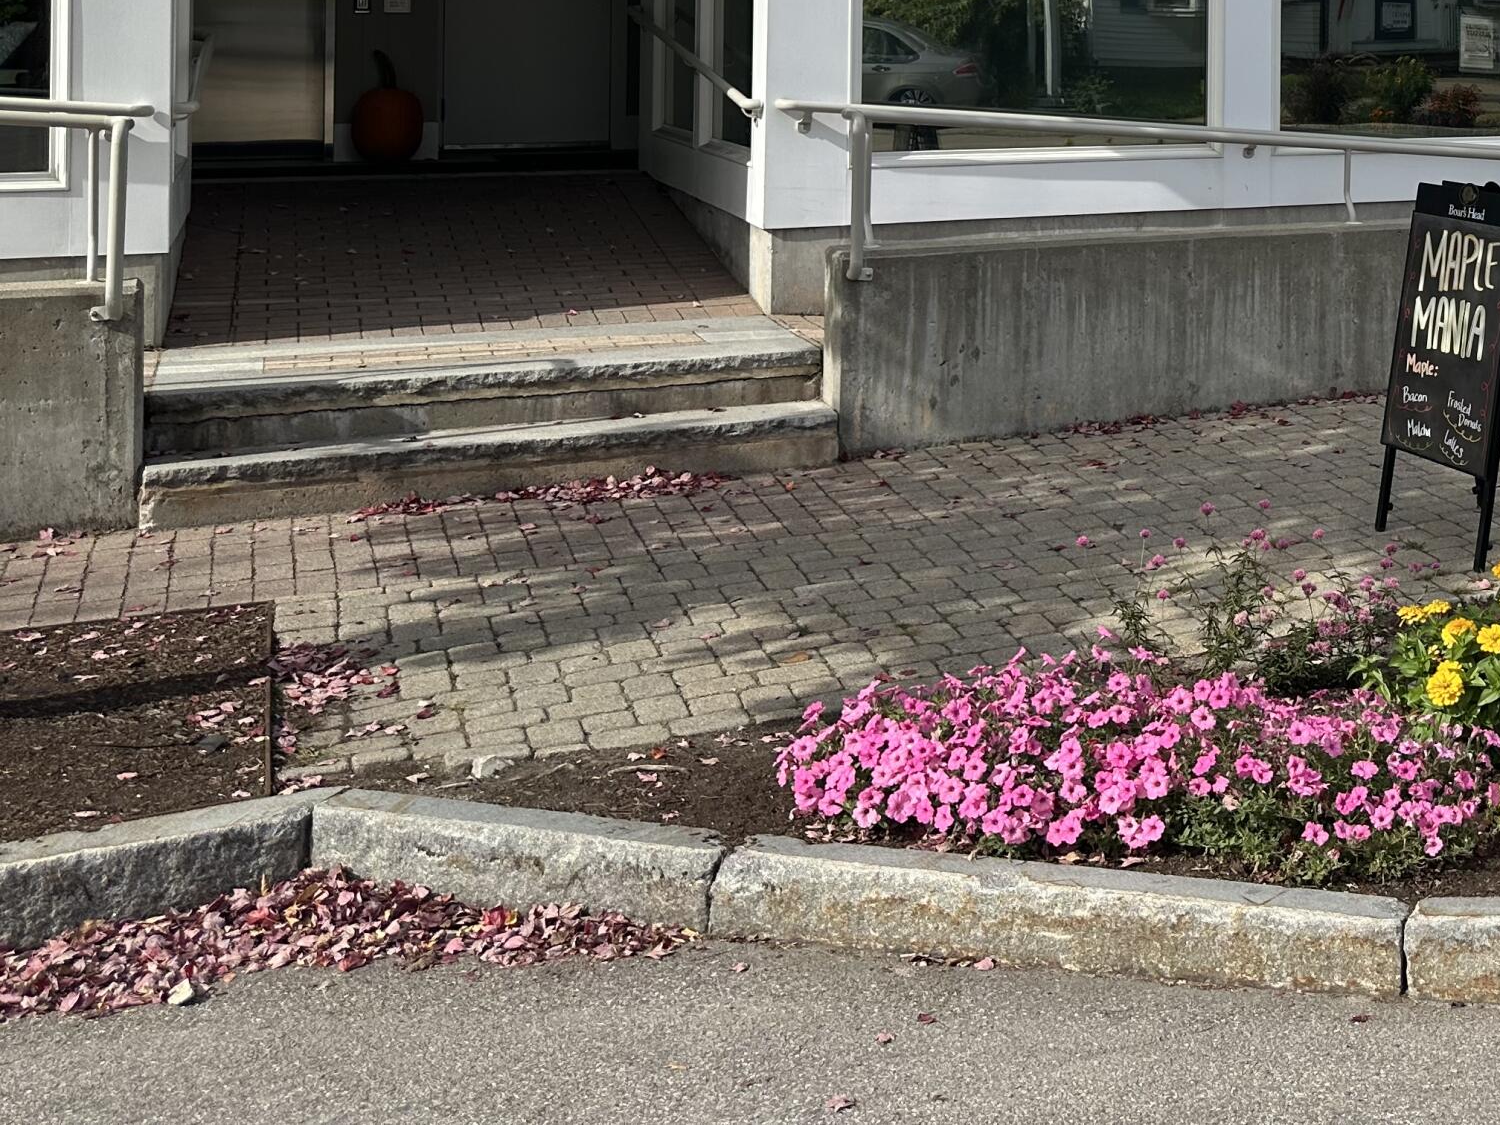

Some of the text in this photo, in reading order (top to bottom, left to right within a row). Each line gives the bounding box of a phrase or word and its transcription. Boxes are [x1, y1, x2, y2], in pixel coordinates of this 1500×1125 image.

[1467, 207, 1485, 221] Head
[1411, 295, 1486, 361] MANIA
[1406, 353, 1439, 378] Maple:
[1403, 386, 1428, 404] Bacon
[1447, 390, 1472, 416] Frosted
[1407, 418, 1432, 438] Matcha
[1458, 413, 1482, 432] Donuts
[1443, 429, 1464, 458] Lattes
